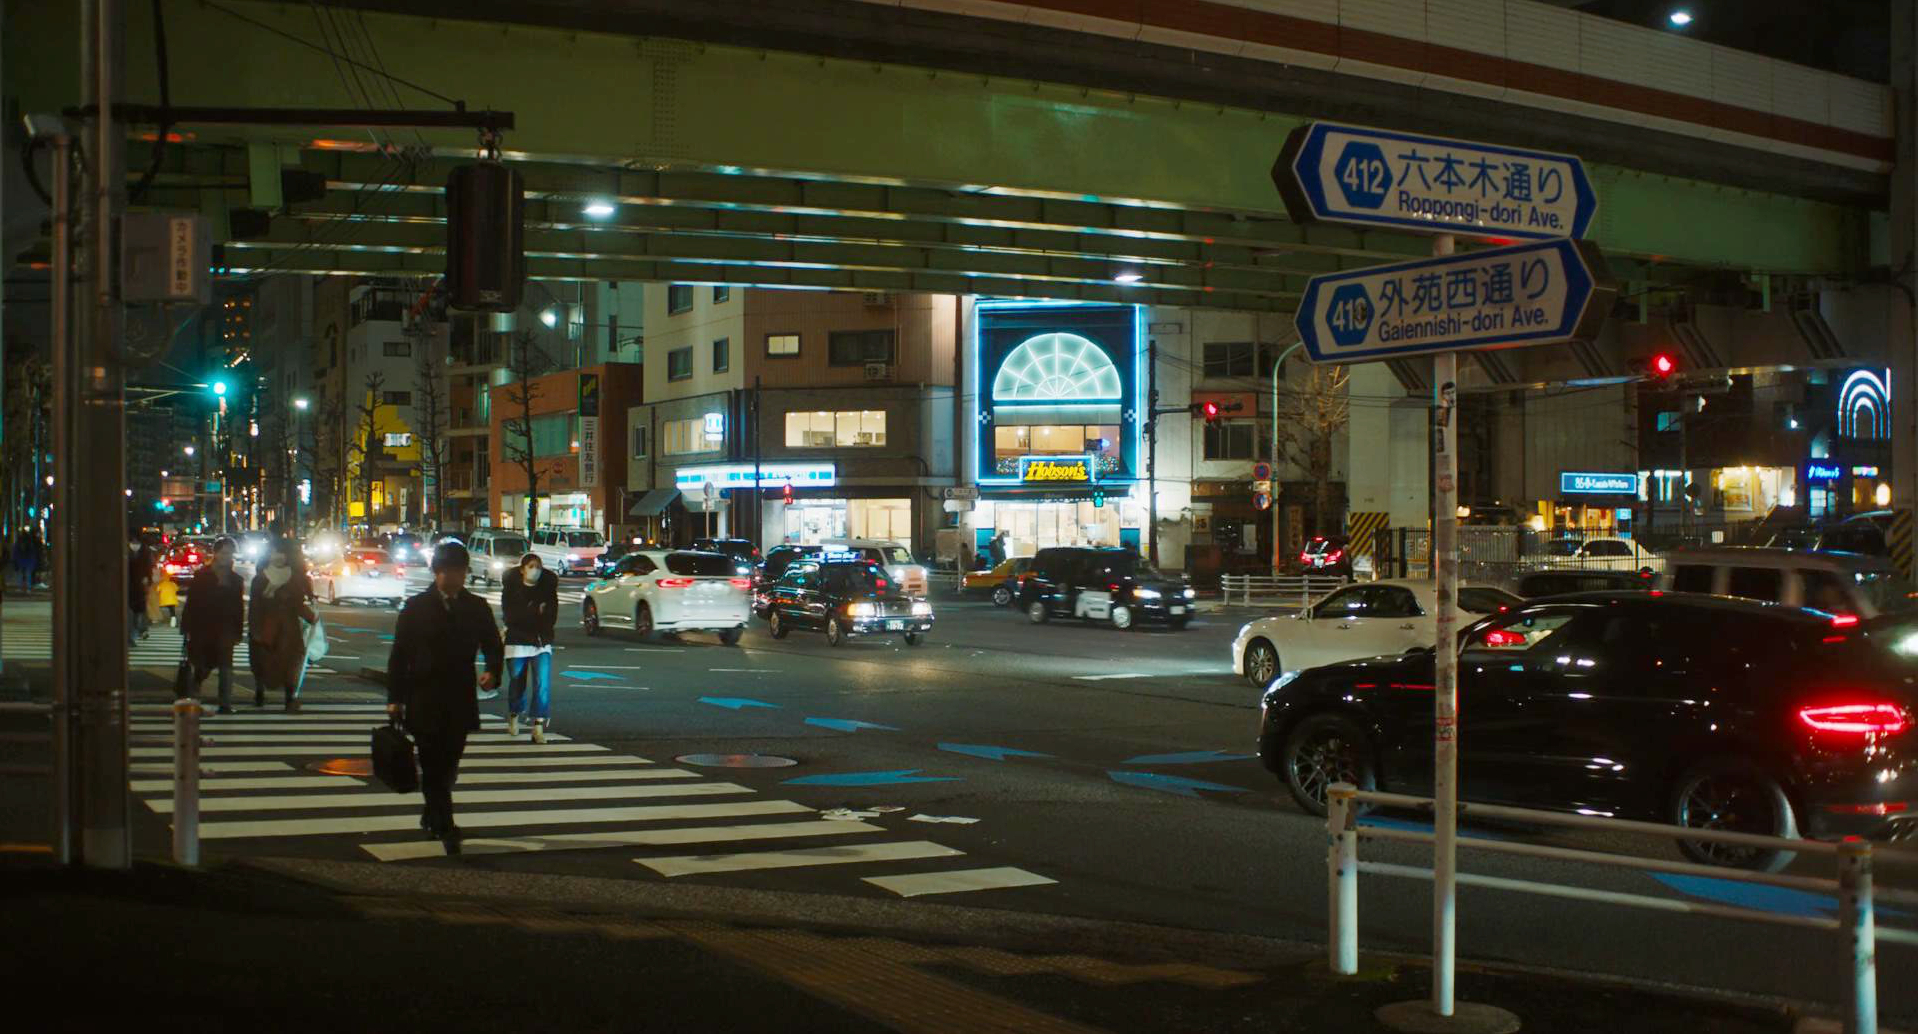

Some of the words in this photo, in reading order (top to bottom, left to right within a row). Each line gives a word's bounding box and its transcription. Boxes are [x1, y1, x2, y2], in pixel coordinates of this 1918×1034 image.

[1343, 157, 1385, 194] 412
[1397, 149, 1563, 204] 六本木通り
[1398, 190, 1522, 223] Roppongi-dori
[1529, 205, 1563, 229] Ave.
[1379, 258, 1549, 318] 外苑西通り
[1378, 306, 1504, 342] Gaiennishi-dori
[1510, 303, 1549, 328] Ave.
[584, 420, 595, 484] 三井住友銀行
[1025, 460, 1089, 480] Hobson's
